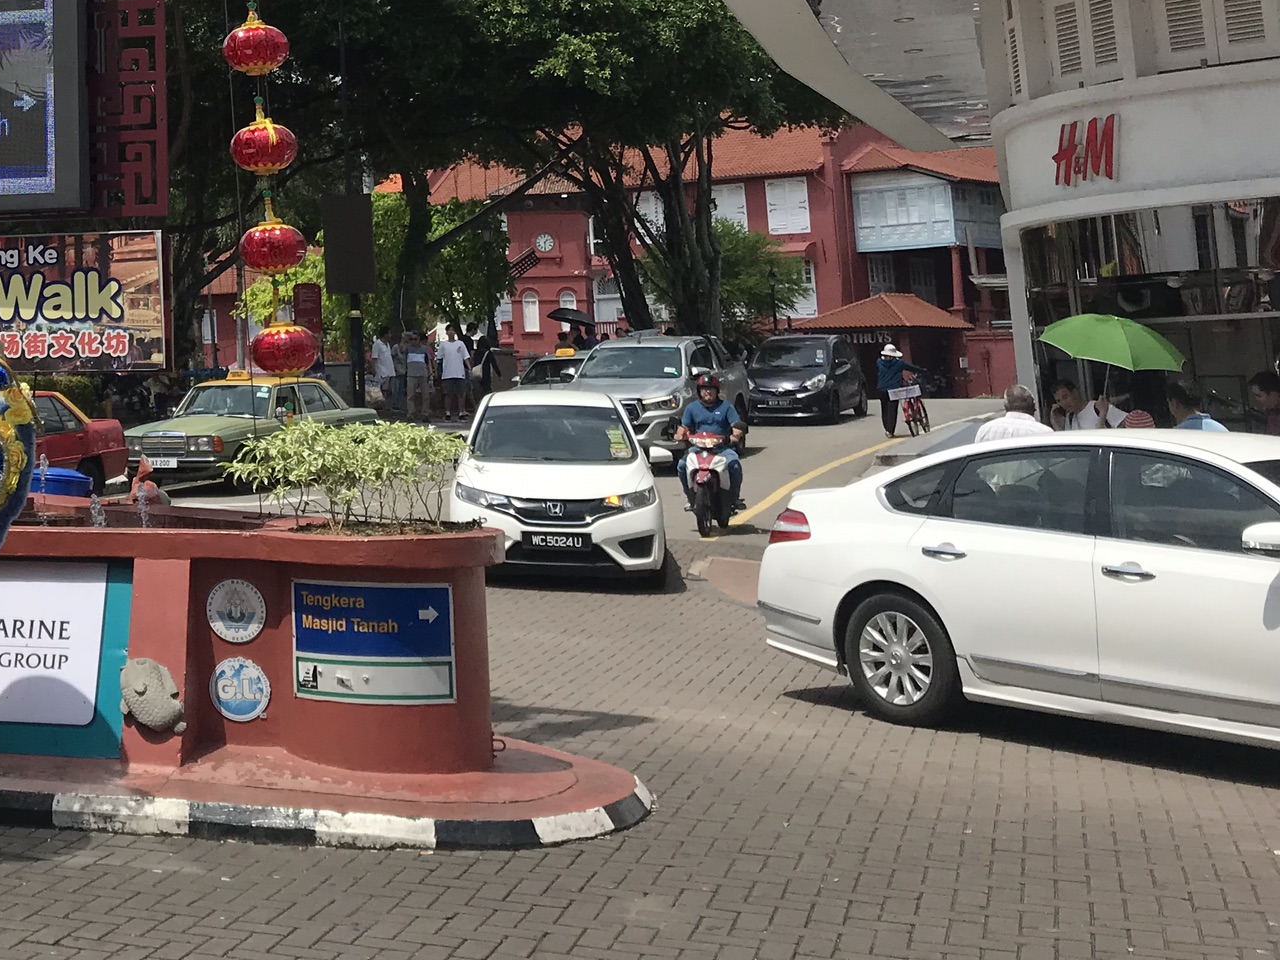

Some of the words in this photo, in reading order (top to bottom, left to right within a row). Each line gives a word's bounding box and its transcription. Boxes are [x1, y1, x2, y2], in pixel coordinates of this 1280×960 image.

[1052, 113, 1116, 187] H&M
[28, 244, 58, 265] Ke
[301, 591, 365, 610] Tengkera
[302, 614, 347, 634] Masjid
[351, 618, 399, 633] Tanah
